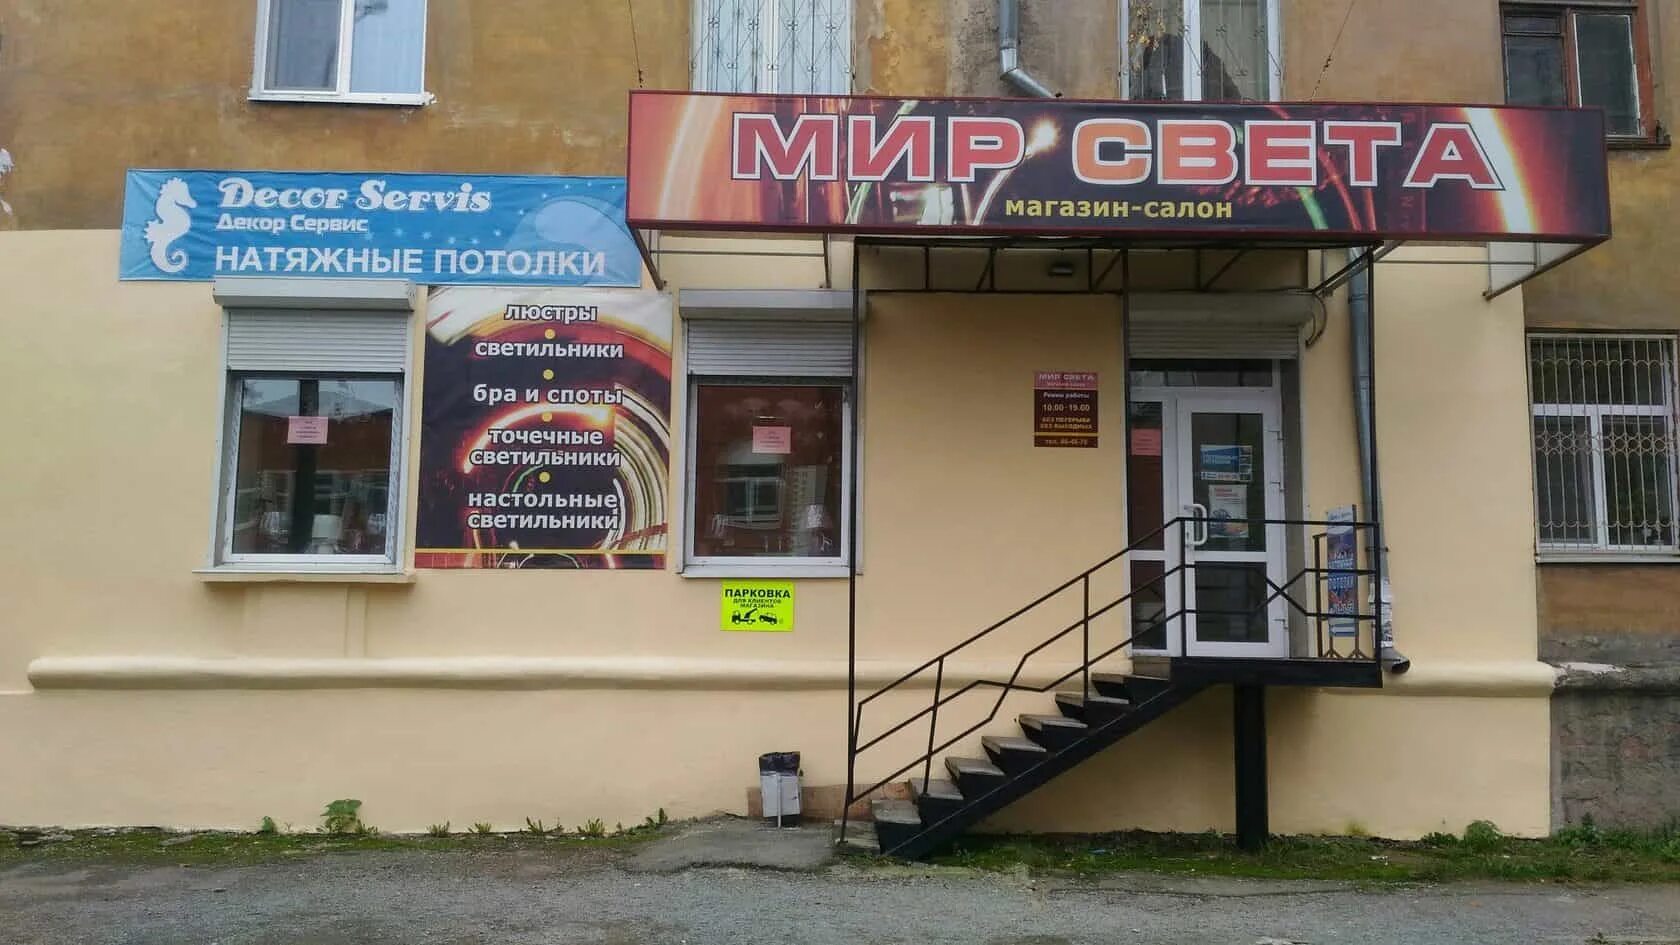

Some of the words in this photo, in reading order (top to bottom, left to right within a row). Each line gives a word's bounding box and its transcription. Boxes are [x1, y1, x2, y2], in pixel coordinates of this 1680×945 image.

[732, 112, 1026, 182] МИР
[1071, 118, 1506, 191] СВЕТА
[217, 177, 348, 209] Decor
[355, 179, 491, 212] Servis
[1005, 199, 1233, 219] магазин-салон
[215, 213, 286, 234] Декор
[290, 214, 369, 235] Сервис
[215, 246, 423, 274] НАТЯЖНЫЕ
[434, 249, 606, 276] ПОТОЛКИ
[504, 304, 598, 324] люстры
[474, 341, 624, 358] светильники
[473, 384, 517, 405] бра
[525, 389, 539, 403] и
[547, 389, 623, 405] споты
[488, 429, 604, 445] точечные
[470, 449, 621, 466] светильники
[467, 493, 618, 508] настольные
[467, 513, 619, 529] светильники
[724, 588, 791, 599] ПАРКОВКА
